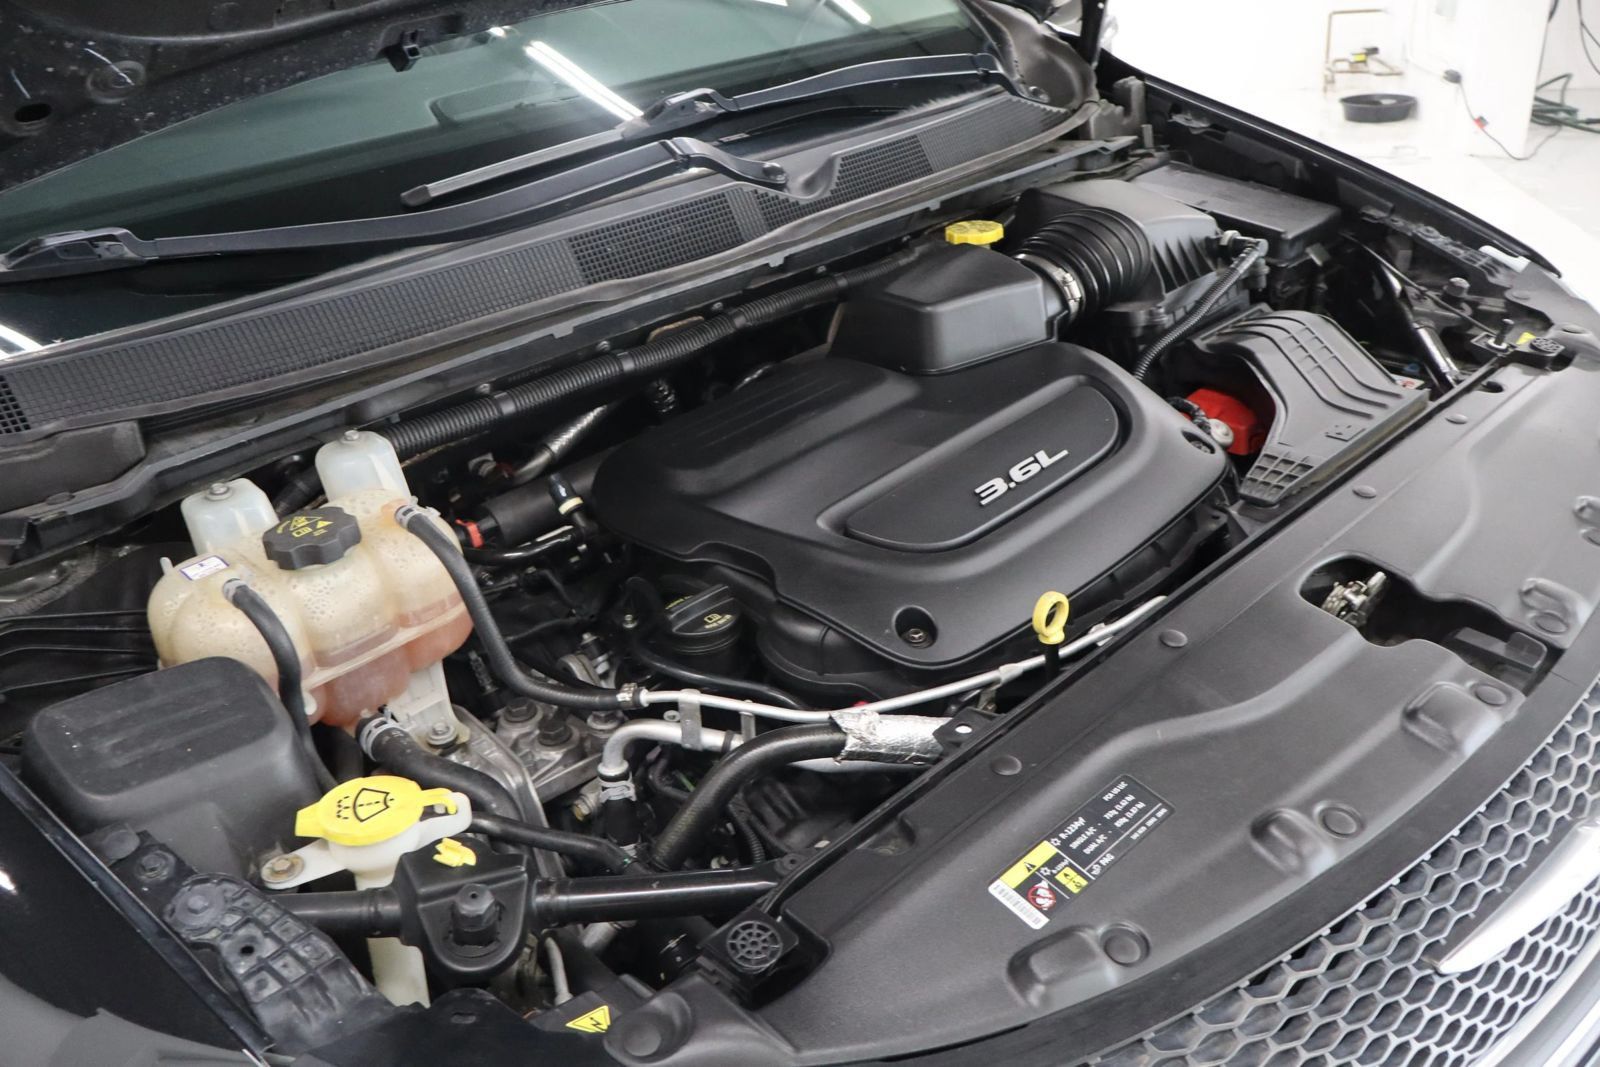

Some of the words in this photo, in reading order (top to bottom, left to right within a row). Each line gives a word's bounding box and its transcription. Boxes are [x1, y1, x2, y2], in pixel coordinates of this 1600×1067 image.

[974, 449, 1069, 505] 3.6L
[1059, 816, 1086, 839] R-1234yf
[1099, 853, 1115, 866] PAG
